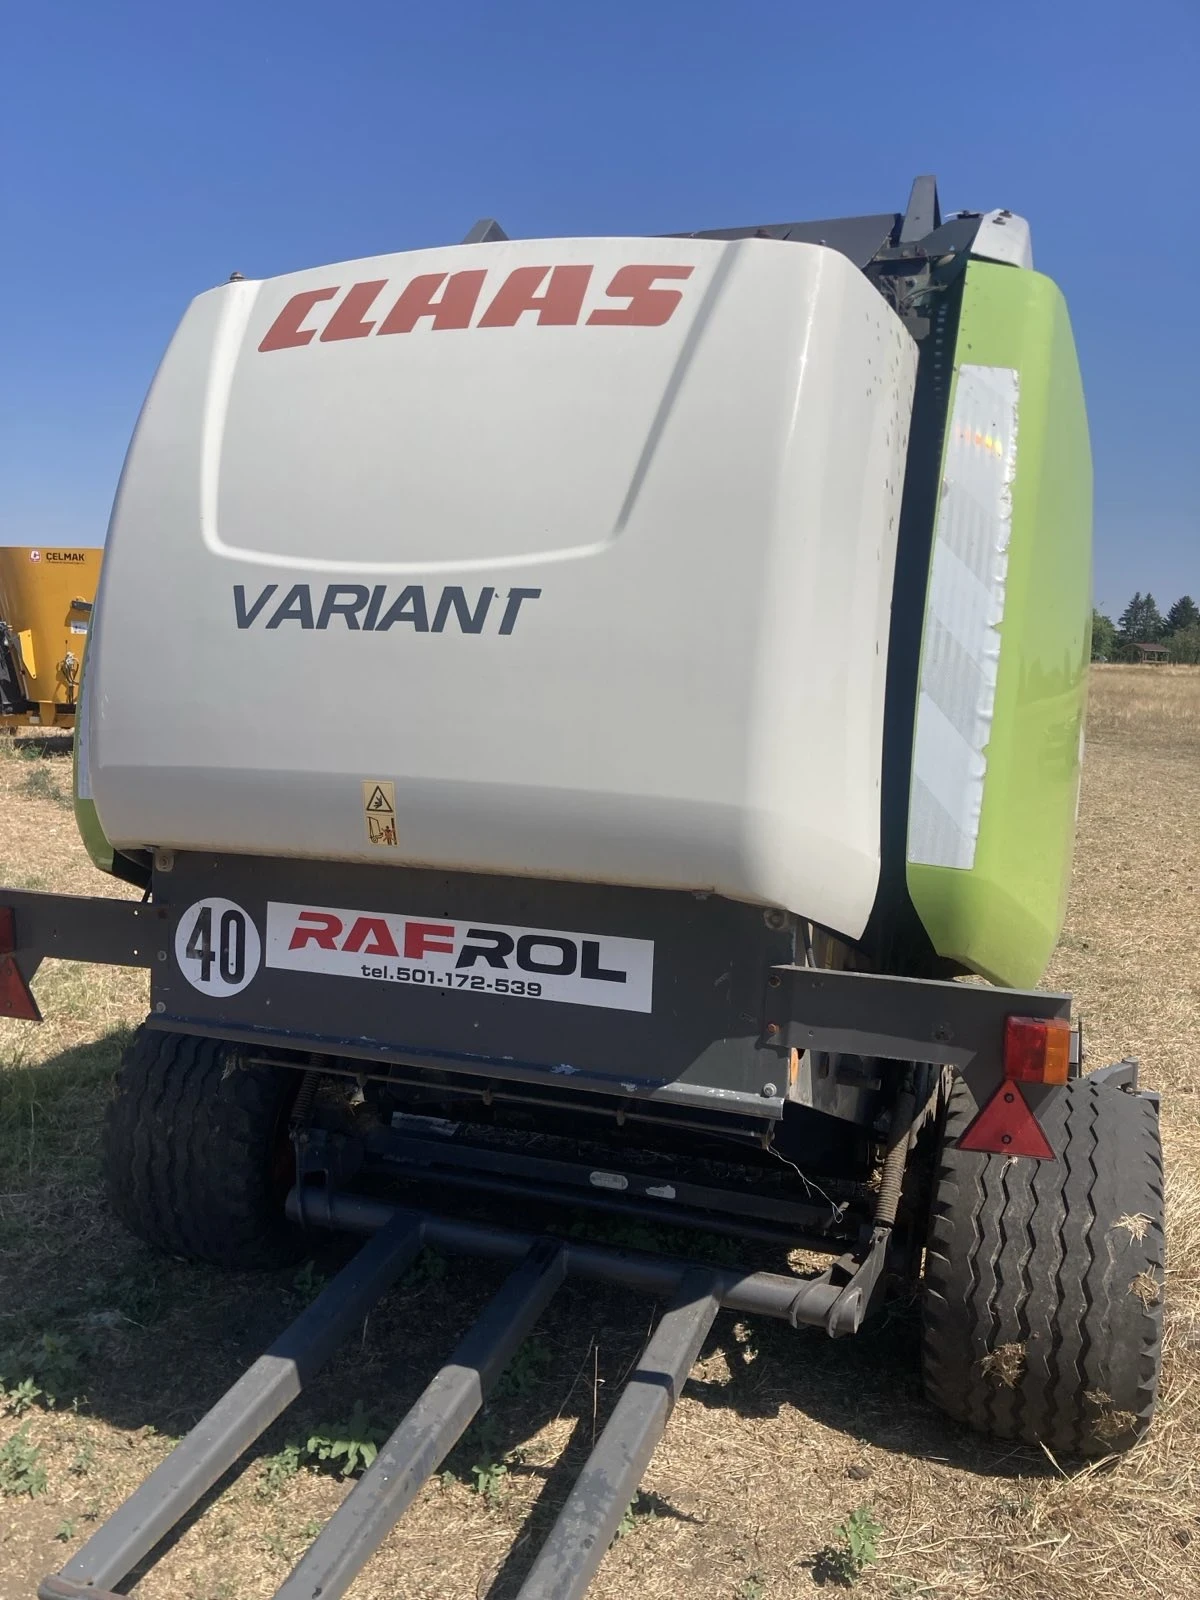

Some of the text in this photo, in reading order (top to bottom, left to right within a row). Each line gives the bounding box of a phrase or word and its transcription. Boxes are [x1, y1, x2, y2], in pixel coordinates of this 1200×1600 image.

[257, 264, 696, 353] CLAAS
[233, 584, 542, 635] VARIANT
[185, 906, 246, 985] 40
[287, 911, 627, 984] RAFROL
[360, 964, 542, 997] tel.501-172-539
